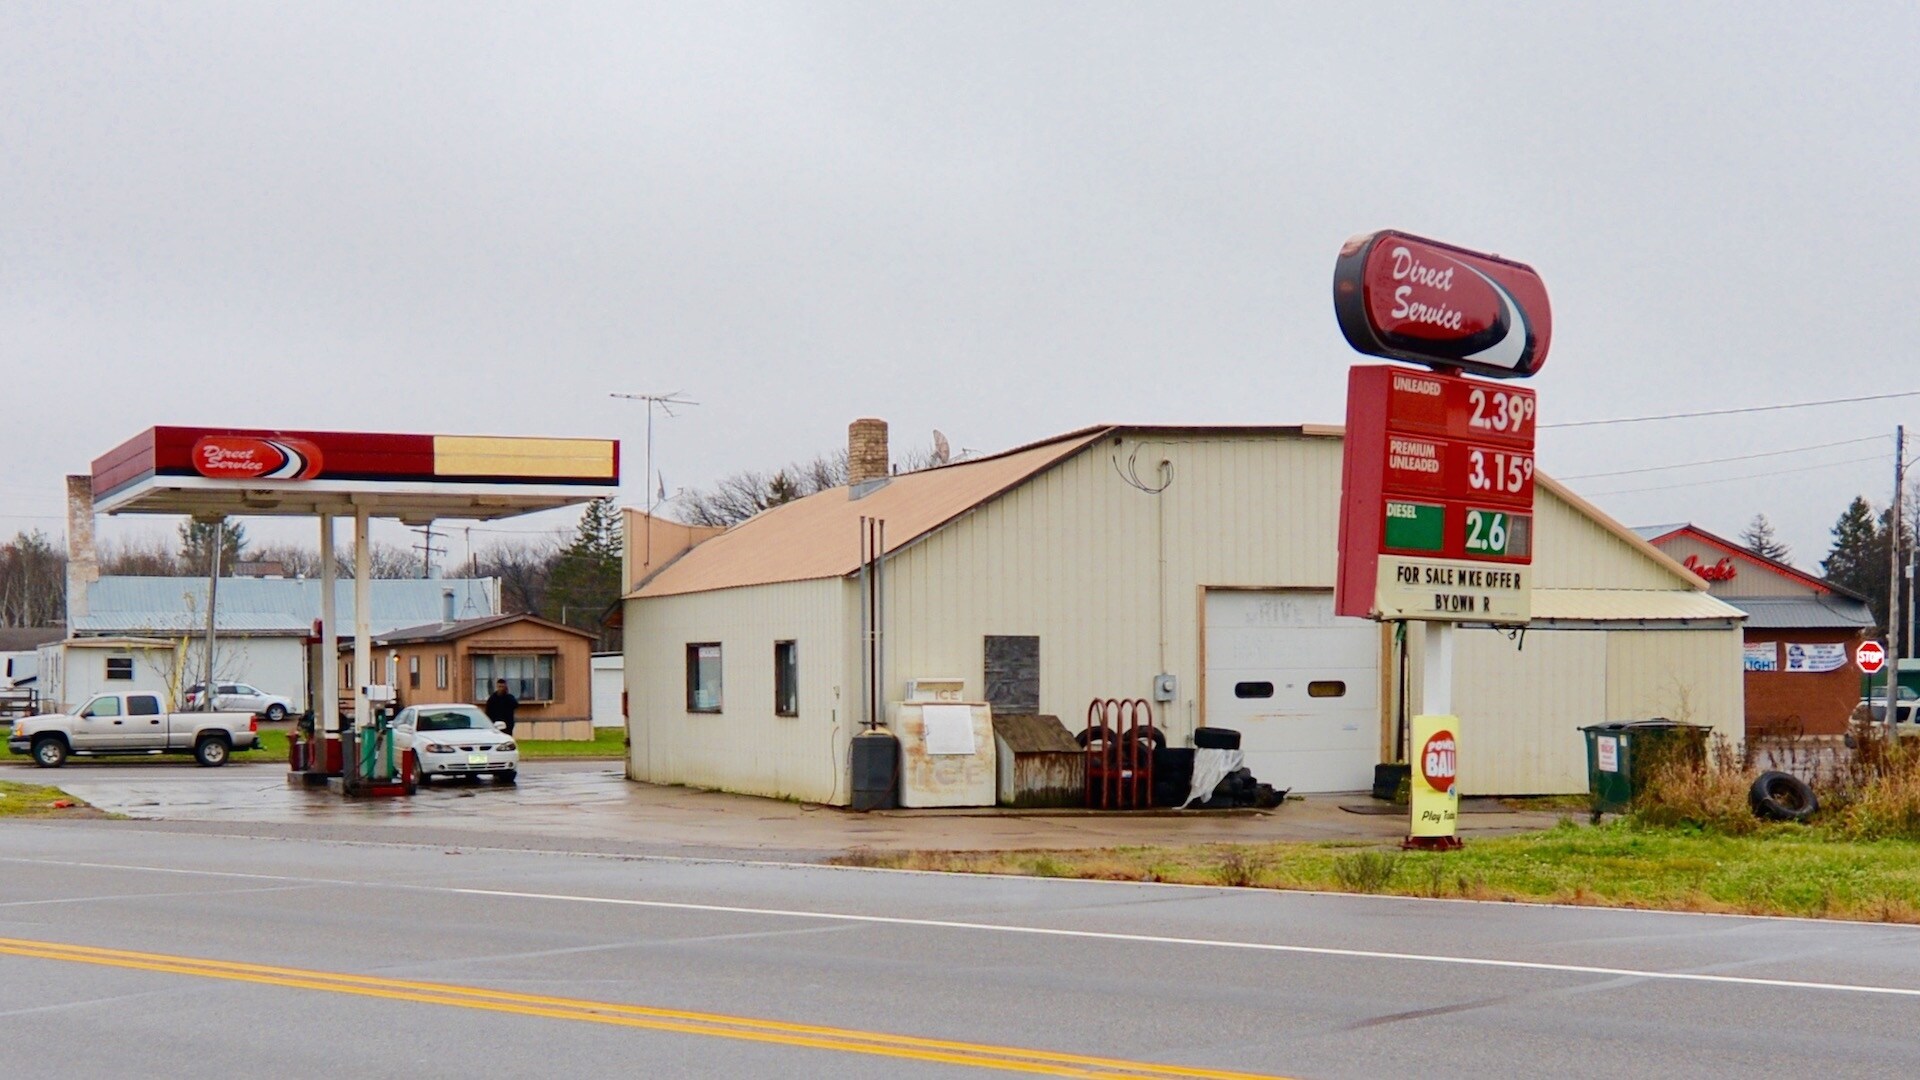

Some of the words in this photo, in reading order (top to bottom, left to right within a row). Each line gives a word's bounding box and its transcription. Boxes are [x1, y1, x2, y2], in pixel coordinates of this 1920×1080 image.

[1392, 246, 1454, 292] Direct
[1391, 285, 1462, 330] Service
[1393, 376, 1441, 396] UNLEADED
[203, 444, 254, 459] Direct
[1389, 440, 1435, 458] PREMIUM
[205, 456, 263, 470] Service
[1389, 456, 1439, 473] UNLEADED
[1386, 503, 1417, 519] DIESEL
[1466, 511, 1505, 550] 2.6
[1397, 565, 1419, 583] FOR
[1426, 568, 1453, 585] SALE
[1486, 572, 1520, 590] OFFER
[1859, 651, 1883, 664] STOP
[935, 689, 960, 700] ICE
[1421, 810, 1441, 824] Play
